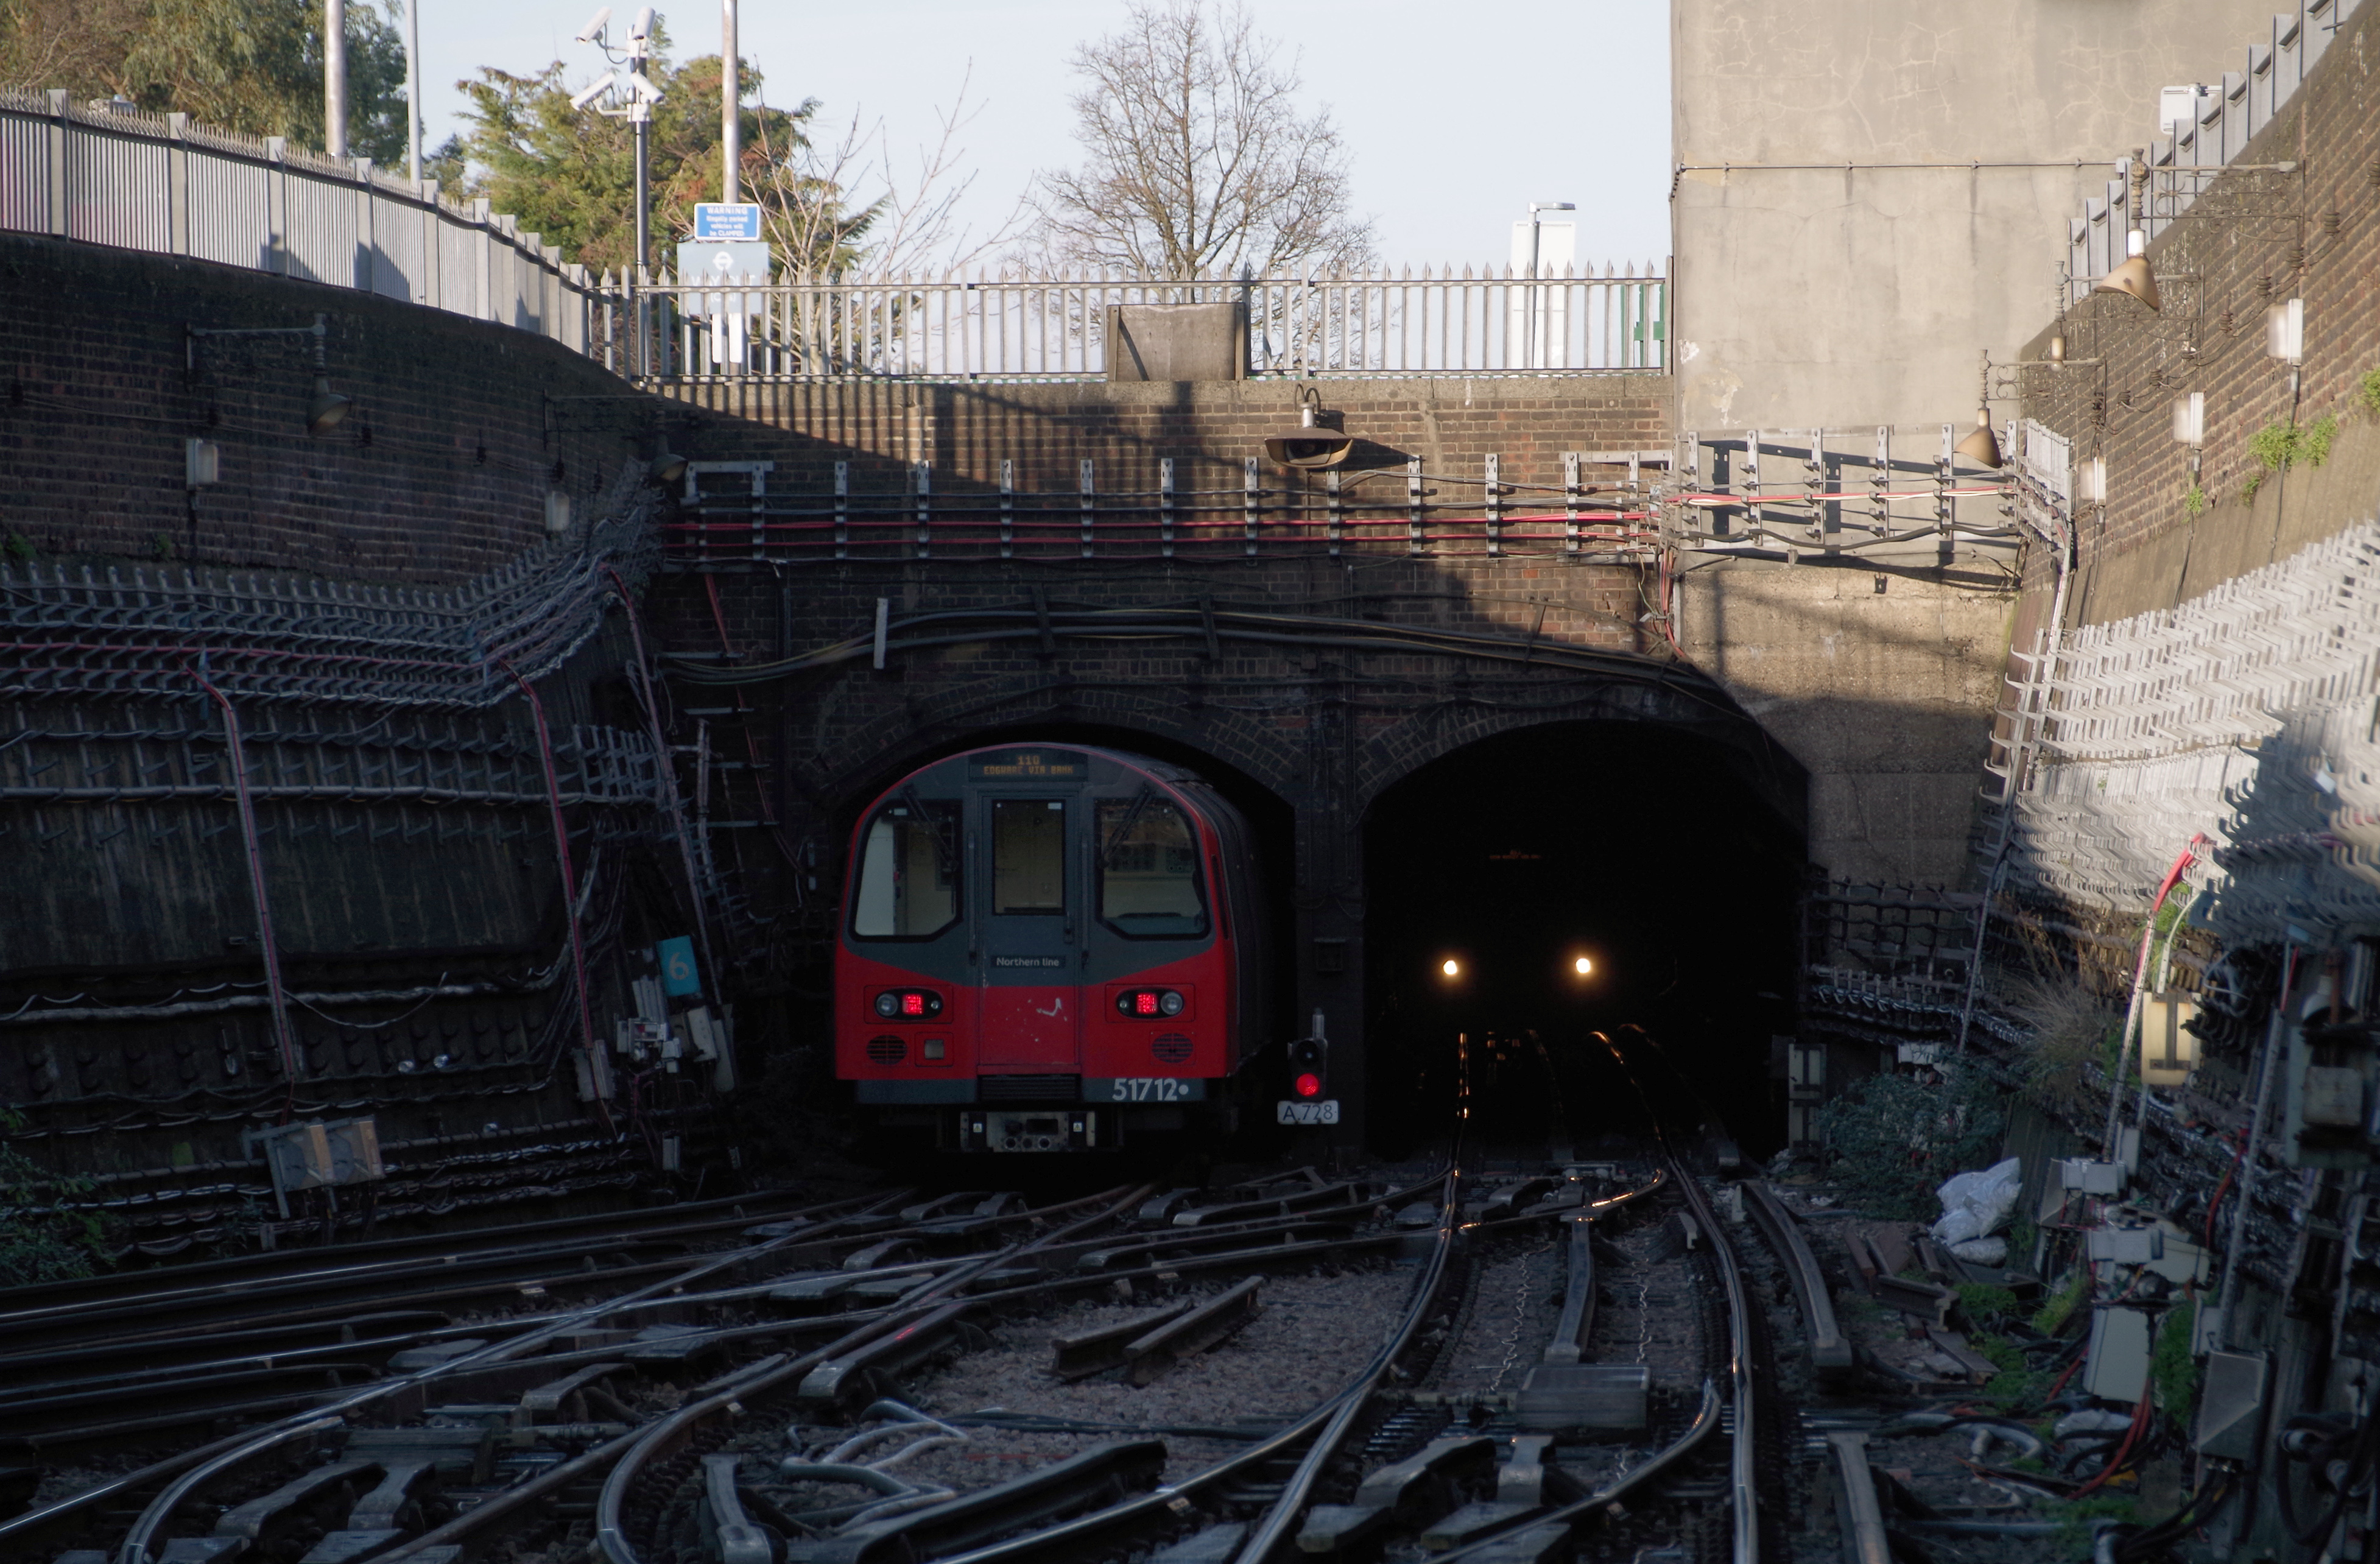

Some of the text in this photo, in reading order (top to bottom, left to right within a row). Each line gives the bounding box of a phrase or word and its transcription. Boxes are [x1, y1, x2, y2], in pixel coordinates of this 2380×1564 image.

[1018, 755, 1040, 765] 110
[984, 766, 1074, 775] EDGWARE VIA BANK
[669, 953, 689, 981] 6
[996, 957, 1060, 967] Northern line
[1283, 1104, 1333, 1121] A.728
